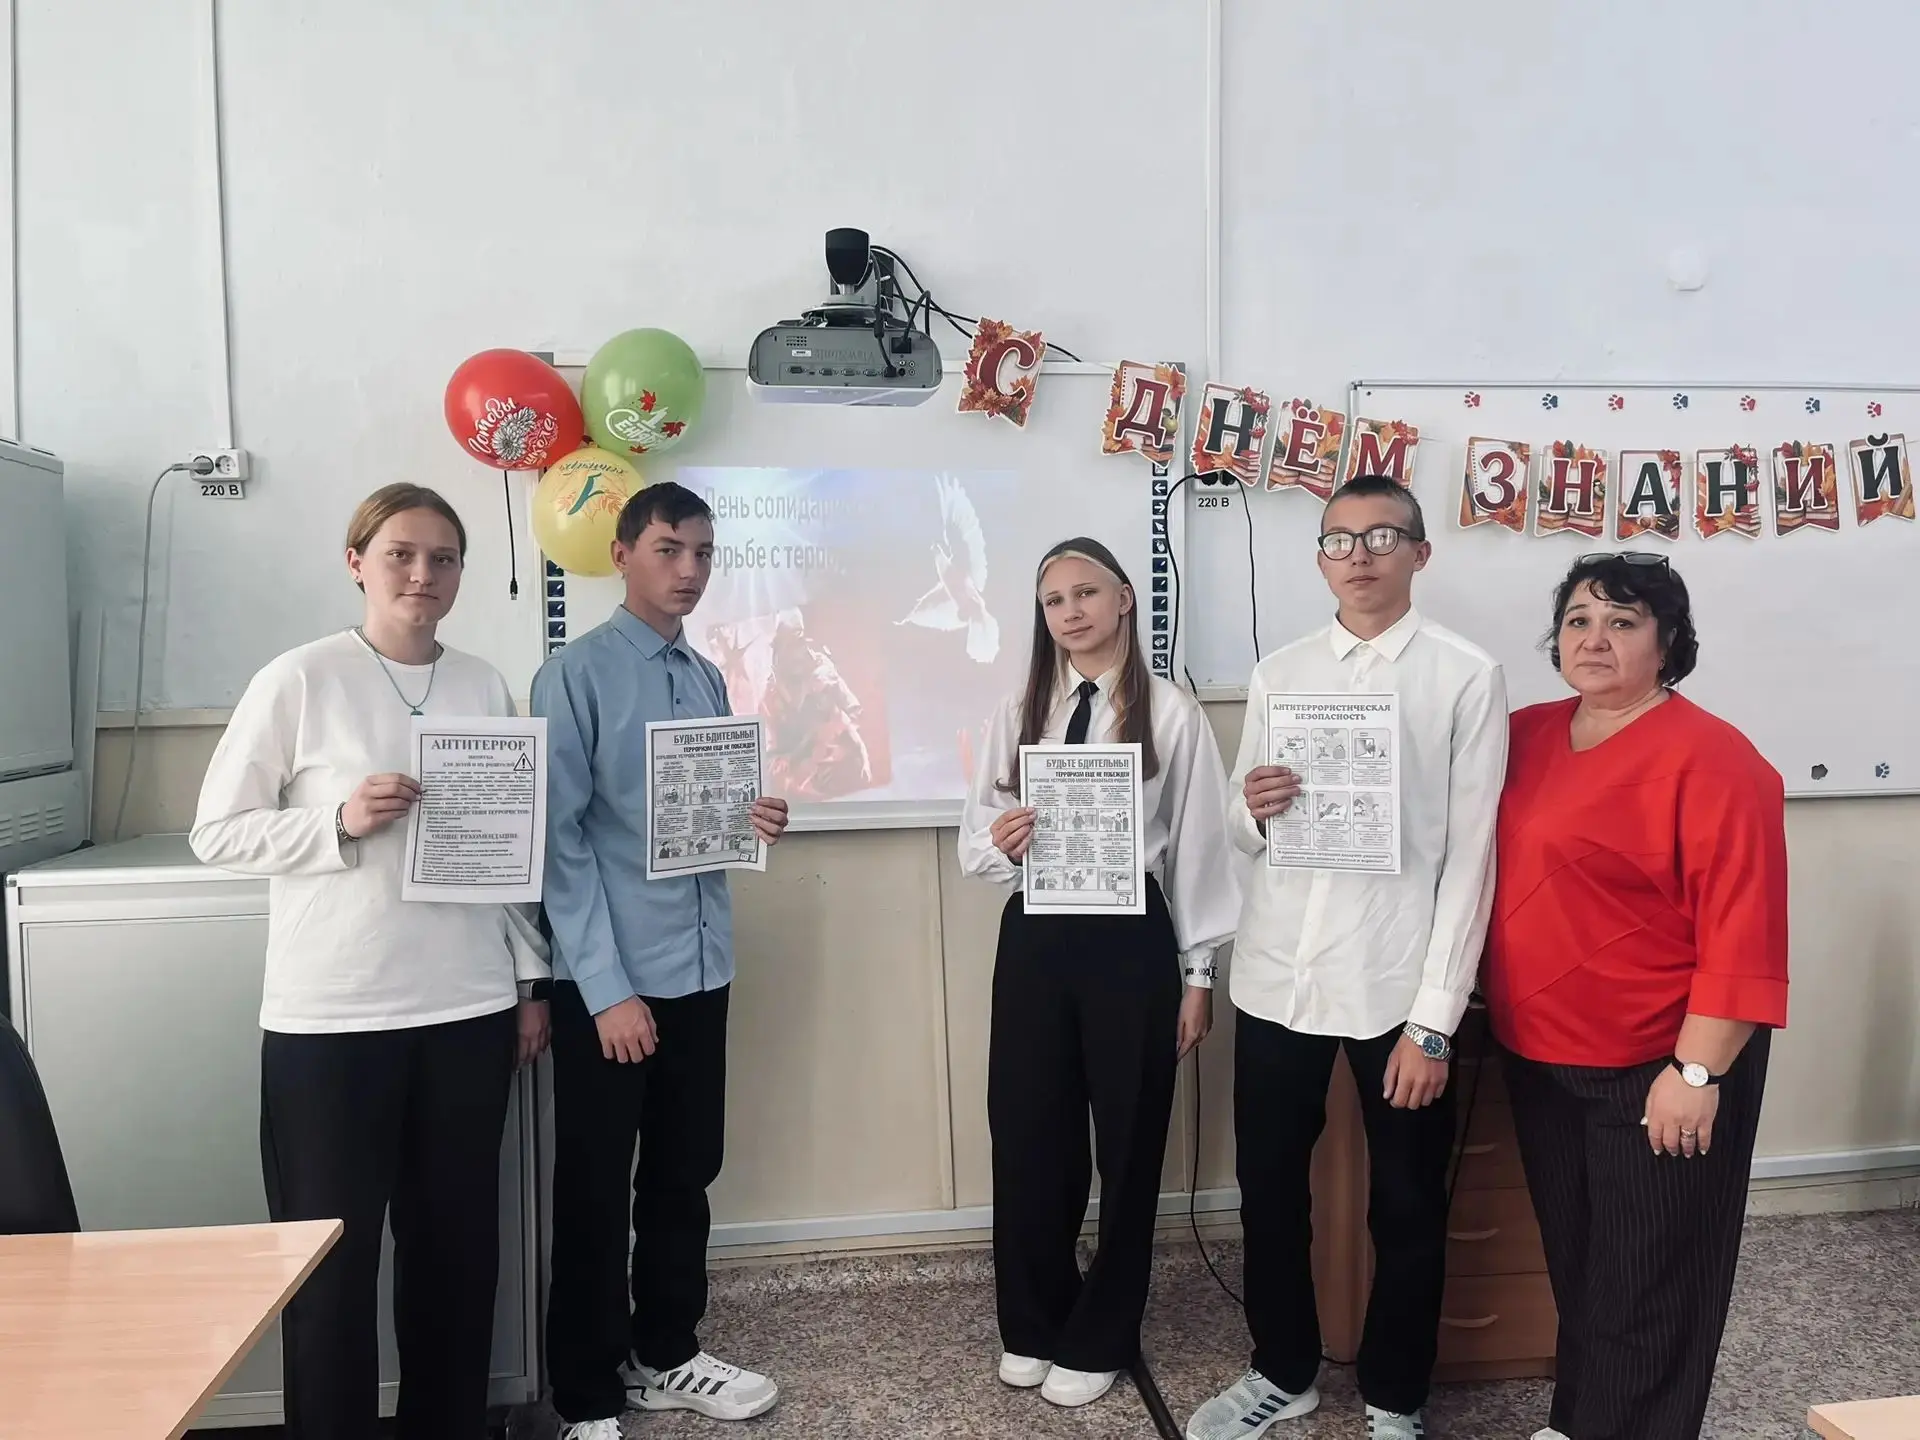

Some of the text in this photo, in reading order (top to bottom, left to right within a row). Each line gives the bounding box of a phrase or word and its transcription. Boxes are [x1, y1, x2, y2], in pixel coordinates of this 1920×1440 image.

[467, 396, 517, 455] Готовы
[976, 336, 1901, 517] С ДНЁМ ЗНАНИЙ
[523, 412, 558, 467] школе!
[201, 484, 239, 496] 220 В
[567, 472, 605, 516] 1
[704, 487, 750, 525] День
[1198, 497, 1230, 508] 220 В
[709, 538, 766, 577] орьбе
[771, 549, 780, 569] с
[1272, 703, 1391, 712] АНТИТЕРРОРИСТИЧЕСКАЯ
[1295, 713, 1367, 721] БЕЗОПАСНОСТЬ
[673, 729, 755, 745] БУДЬТЕ БДИТЕЛЬНЫ!
[431, 738, 527, 751] АНТИТЕРРОР
[683, 744, 713, 753] ТЕРРОРИЗМ
[1046, 758, 1129, 769] БУДЬТЕ БДИТЕЛЬНЫ!
